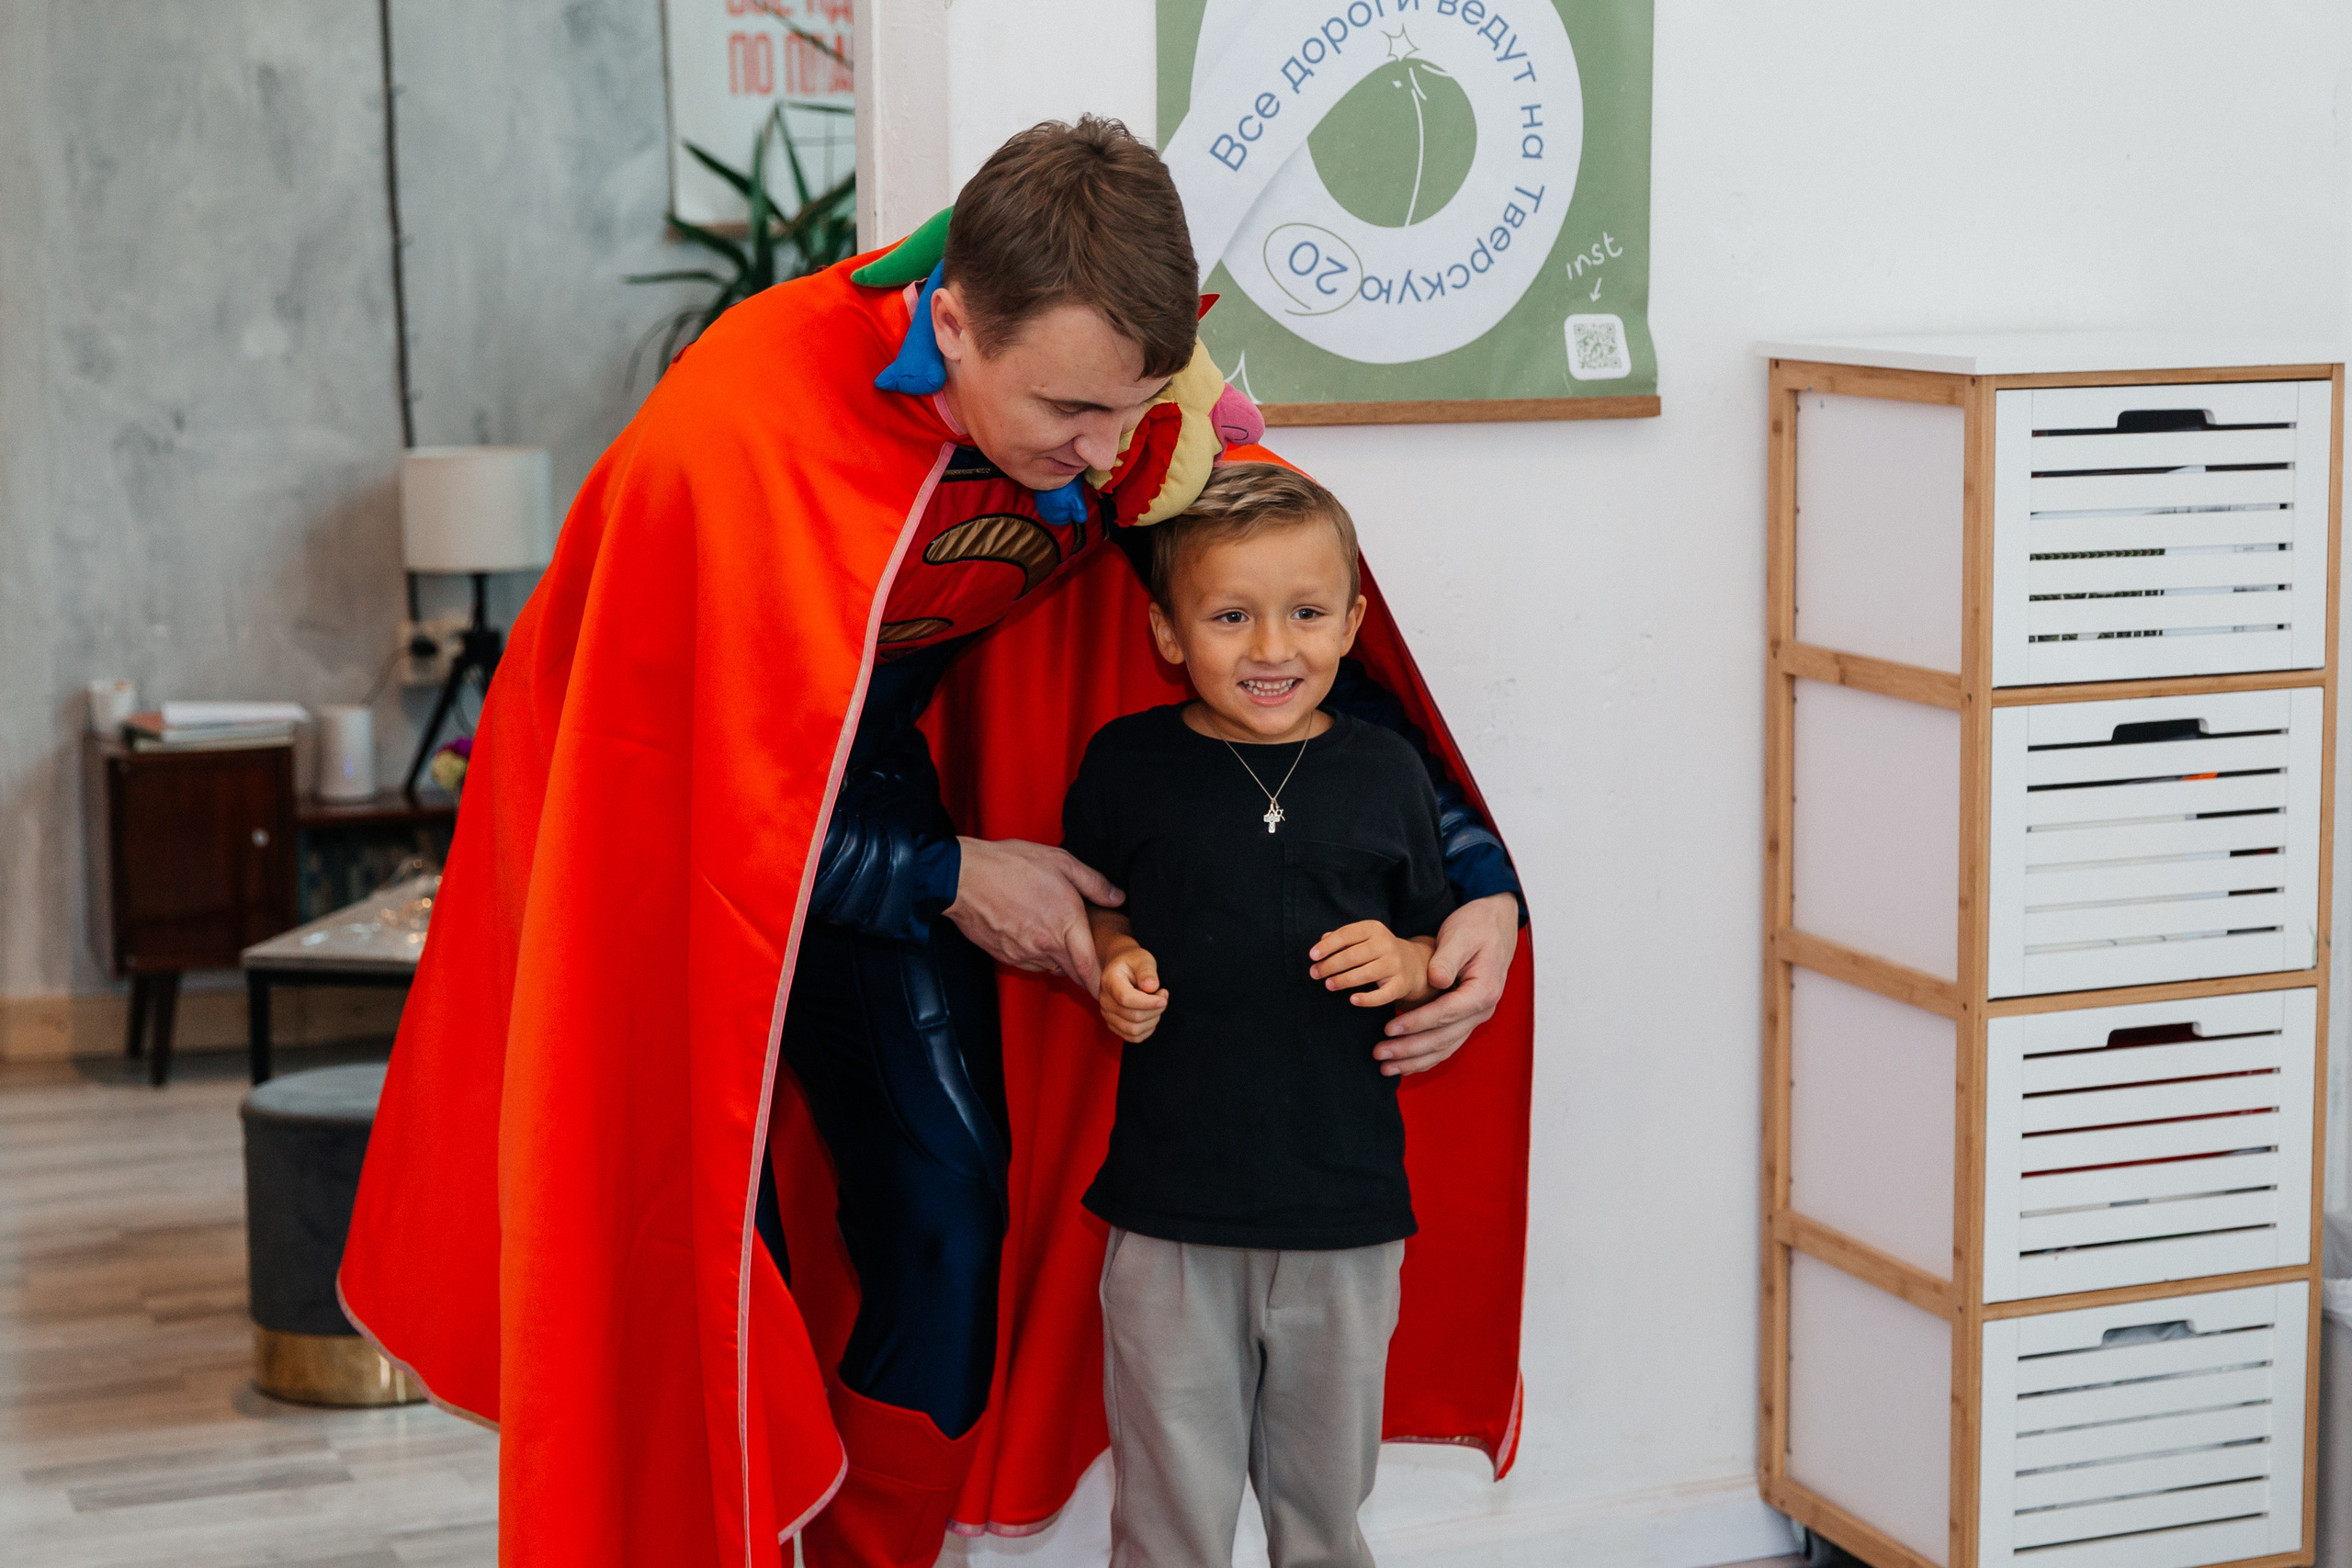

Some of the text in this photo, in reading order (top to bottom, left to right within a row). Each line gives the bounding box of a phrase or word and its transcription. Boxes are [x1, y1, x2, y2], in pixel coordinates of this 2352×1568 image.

[1437, 0, 1537, 83] ведут
[1209, 92, 1281, 173] Все
[1521, 104, 1544, 161] на
[1288, 241, 1349, 295] 20
[1360, 185, 1545, 304] Тверскую
[1566, 231, 1623, 281] inst
